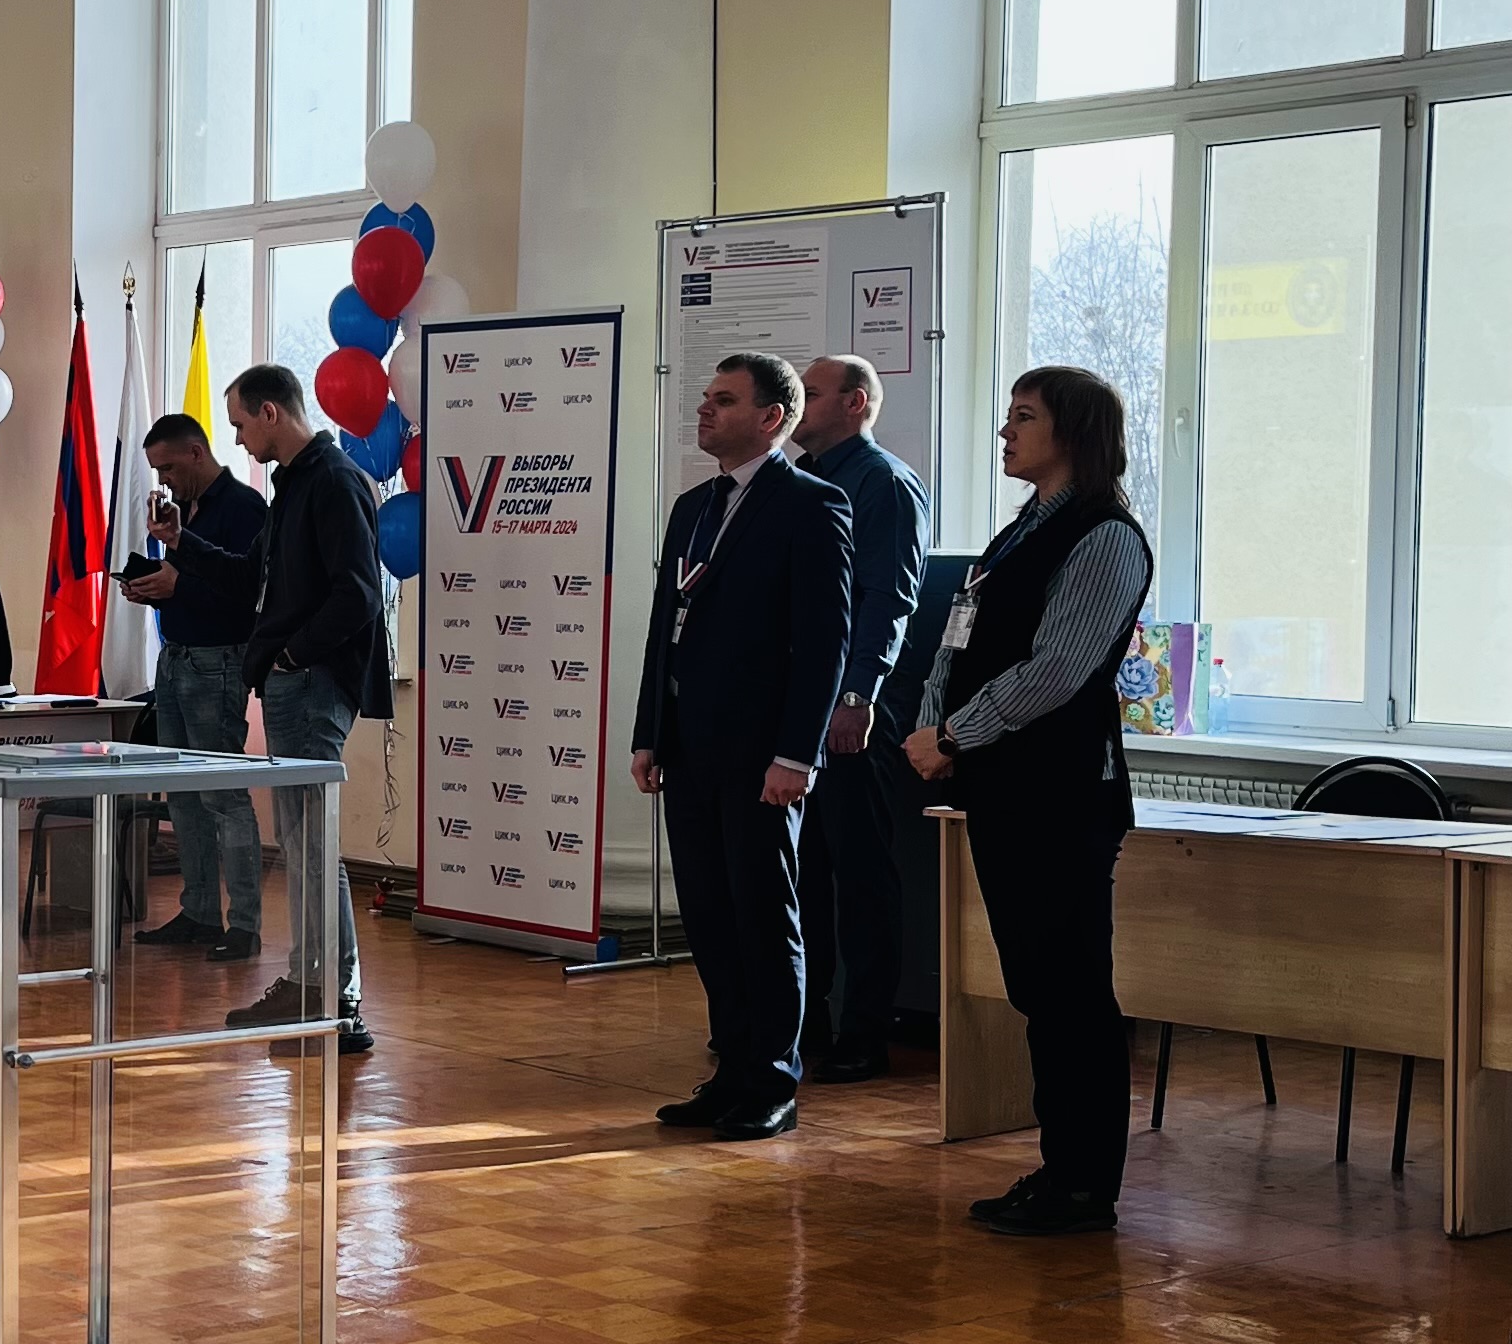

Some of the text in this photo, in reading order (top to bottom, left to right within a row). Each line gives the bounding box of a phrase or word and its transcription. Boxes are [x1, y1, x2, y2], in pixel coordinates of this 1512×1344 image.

[512, 455, 574, 471] ВЫБОРЫ
[504, 477, 592, 495] ПРЕЗИДЕНТА
[497, 499, 552, 515] РОССИИ
[519, 520, 551, 534] МАРТА
[552, 520, 578, 534] 2024
